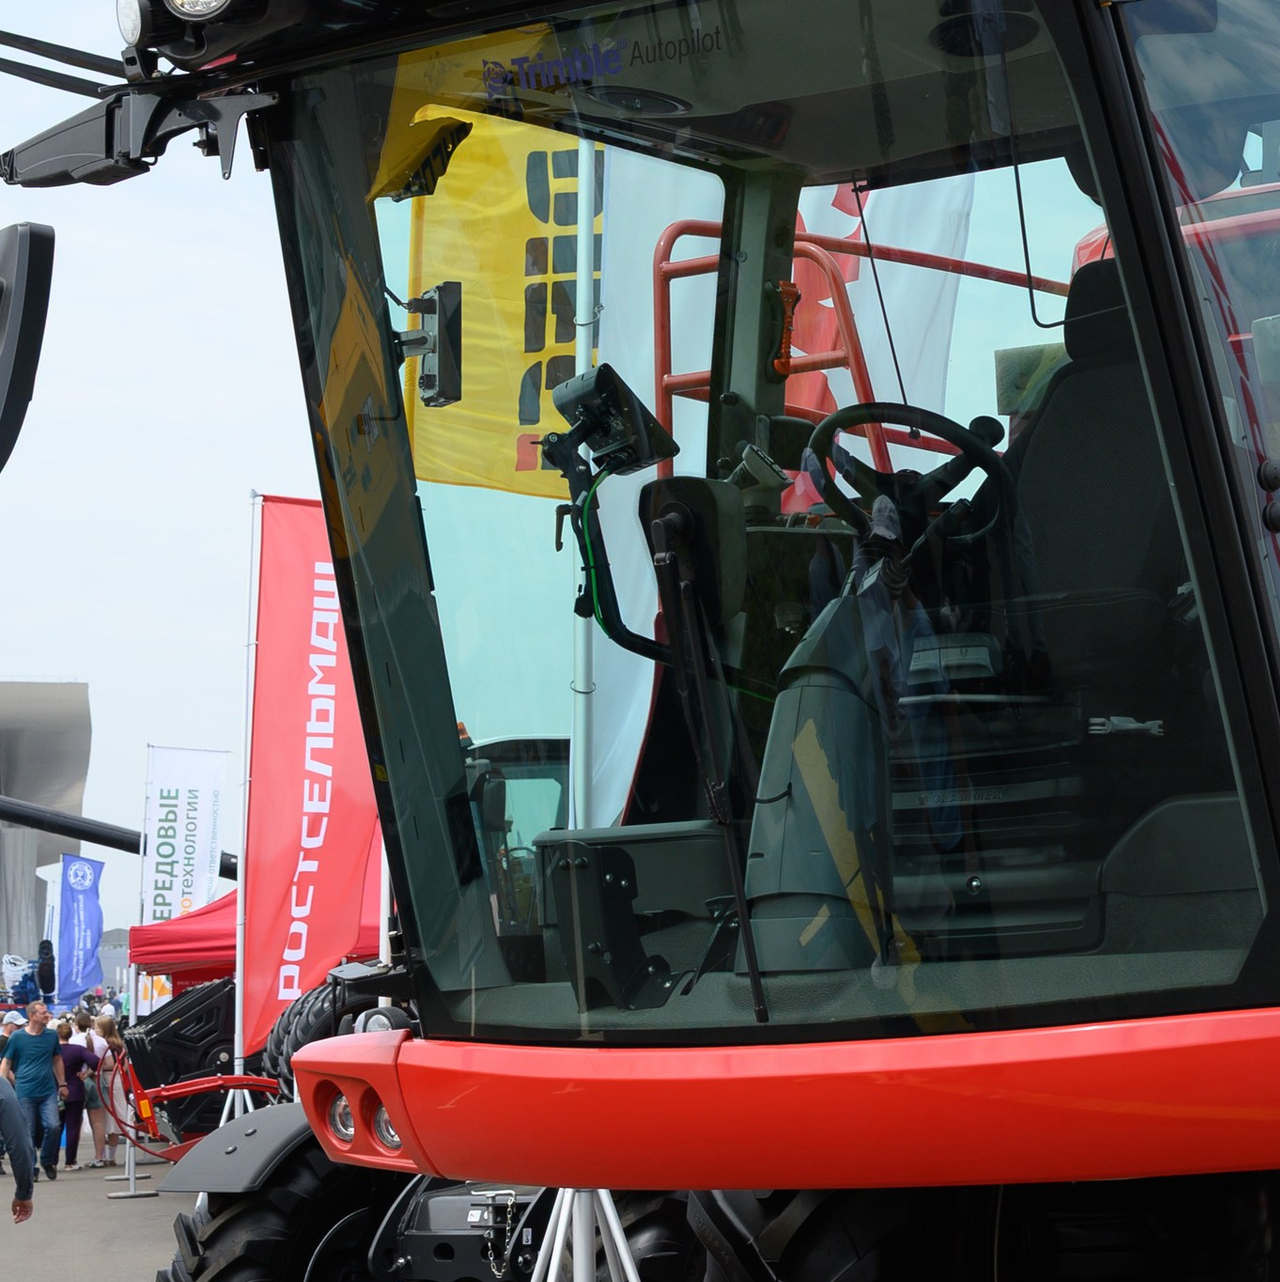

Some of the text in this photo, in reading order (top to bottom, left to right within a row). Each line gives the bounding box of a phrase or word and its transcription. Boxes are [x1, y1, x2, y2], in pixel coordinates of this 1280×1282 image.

[630, 25, 722, 68] Autopilot
[278, 562, 340, 1000] РОСТСЕЛЬМАШ
[207, 790, 220, 874] ответственностью
